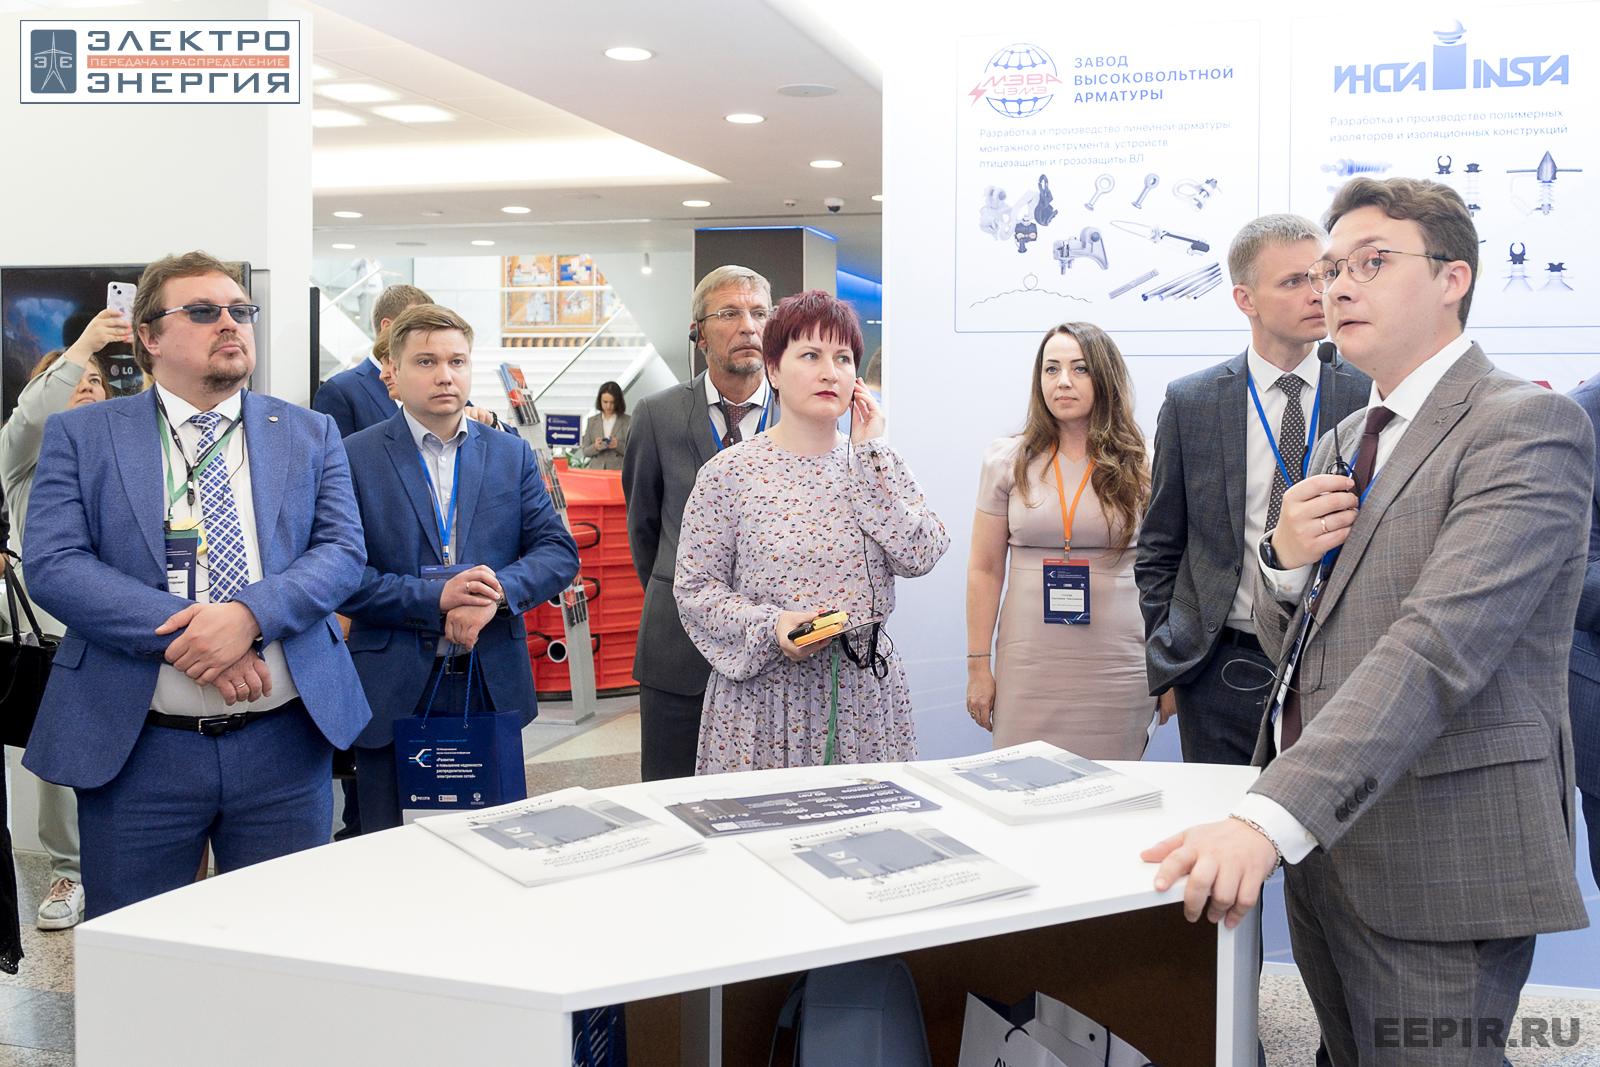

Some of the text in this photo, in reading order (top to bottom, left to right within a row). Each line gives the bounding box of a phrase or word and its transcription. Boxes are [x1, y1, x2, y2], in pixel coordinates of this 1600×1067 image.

[1074, 55, 1129, 69] ЗАВОД
[1074, 67, 1233, 87] ВЫСОКОВОЛЬТНОЙ
[1334, 62, 1426, 94] ИНСТА
[1473, 55, 1569, 89] INSTA
[1074, 88, 1164, 104] АРМАТУРЫ
[1330, 115, 1394, 128] Разработка
[1407, 113, 1486, 127] производство
[1489, 110, 1564, 124] полимерных
[980, 128, 1037, 138] Разработка
[1049, 126, 1120, 136] производство
[1330, 132, 1394, 144] изоляторов
[1407, 128, 1490, 142] изоляционных
[1493, 124, 1568, 138] конструкций
[979, 144, 1040, 153] монтажного
[979, 158, 1046, 168] птицезащиты
[1059, 156, 1126, 166] грозозащиты
[1129, 153, 1144, 163] ВЛ
[122, 366, 133, 375] LG
